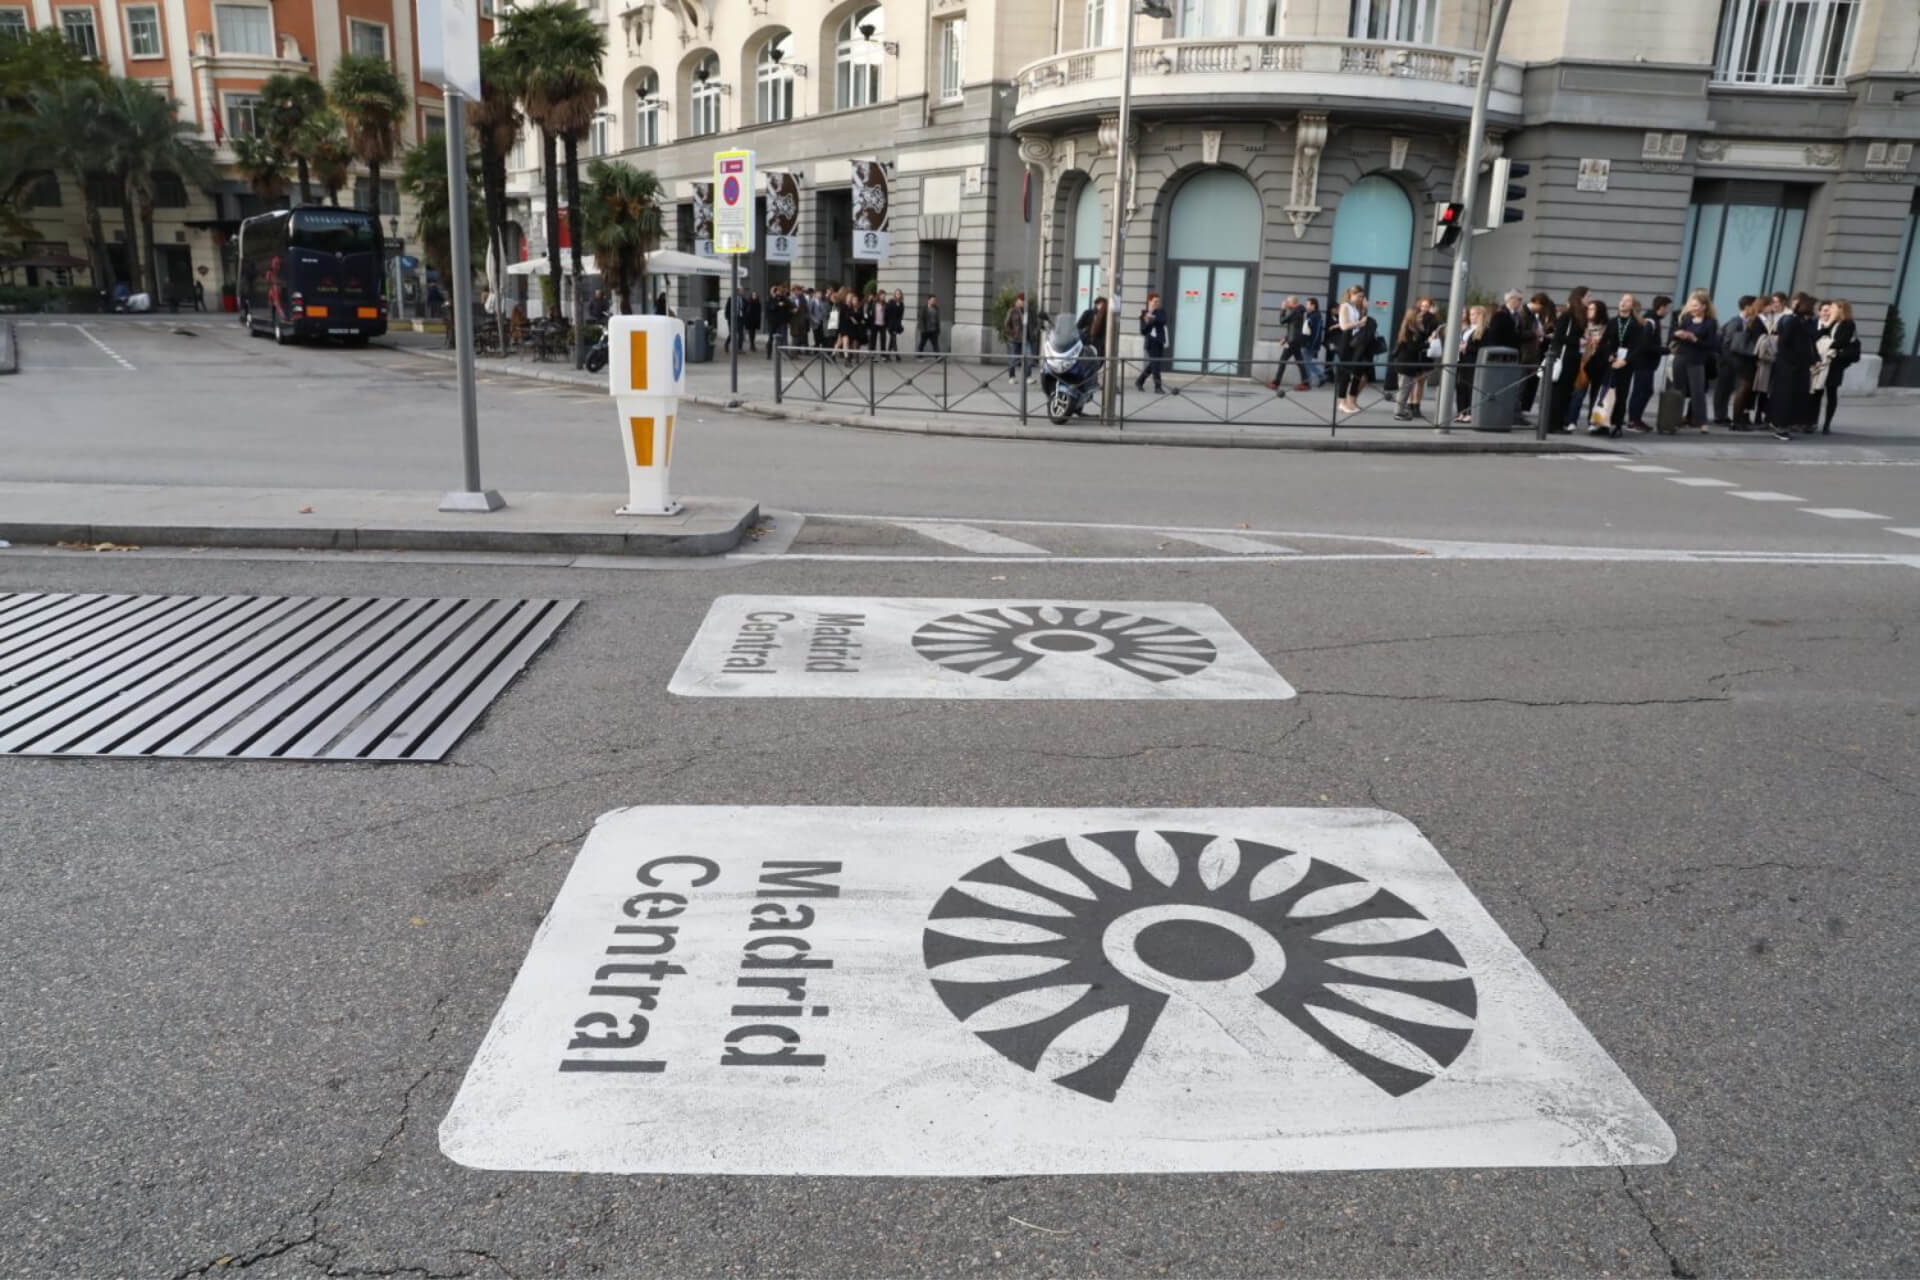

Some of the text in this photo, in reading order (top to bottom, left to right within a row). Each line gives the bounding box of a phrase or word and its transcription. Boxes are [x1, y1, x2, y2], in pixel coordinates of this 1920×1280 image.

[721, 611, 795, 674] Central
[804, 613, 866, 673] Madrid
[558, 855, 720, 1073] Central
[720, 861, 842, 1067] Madrid
